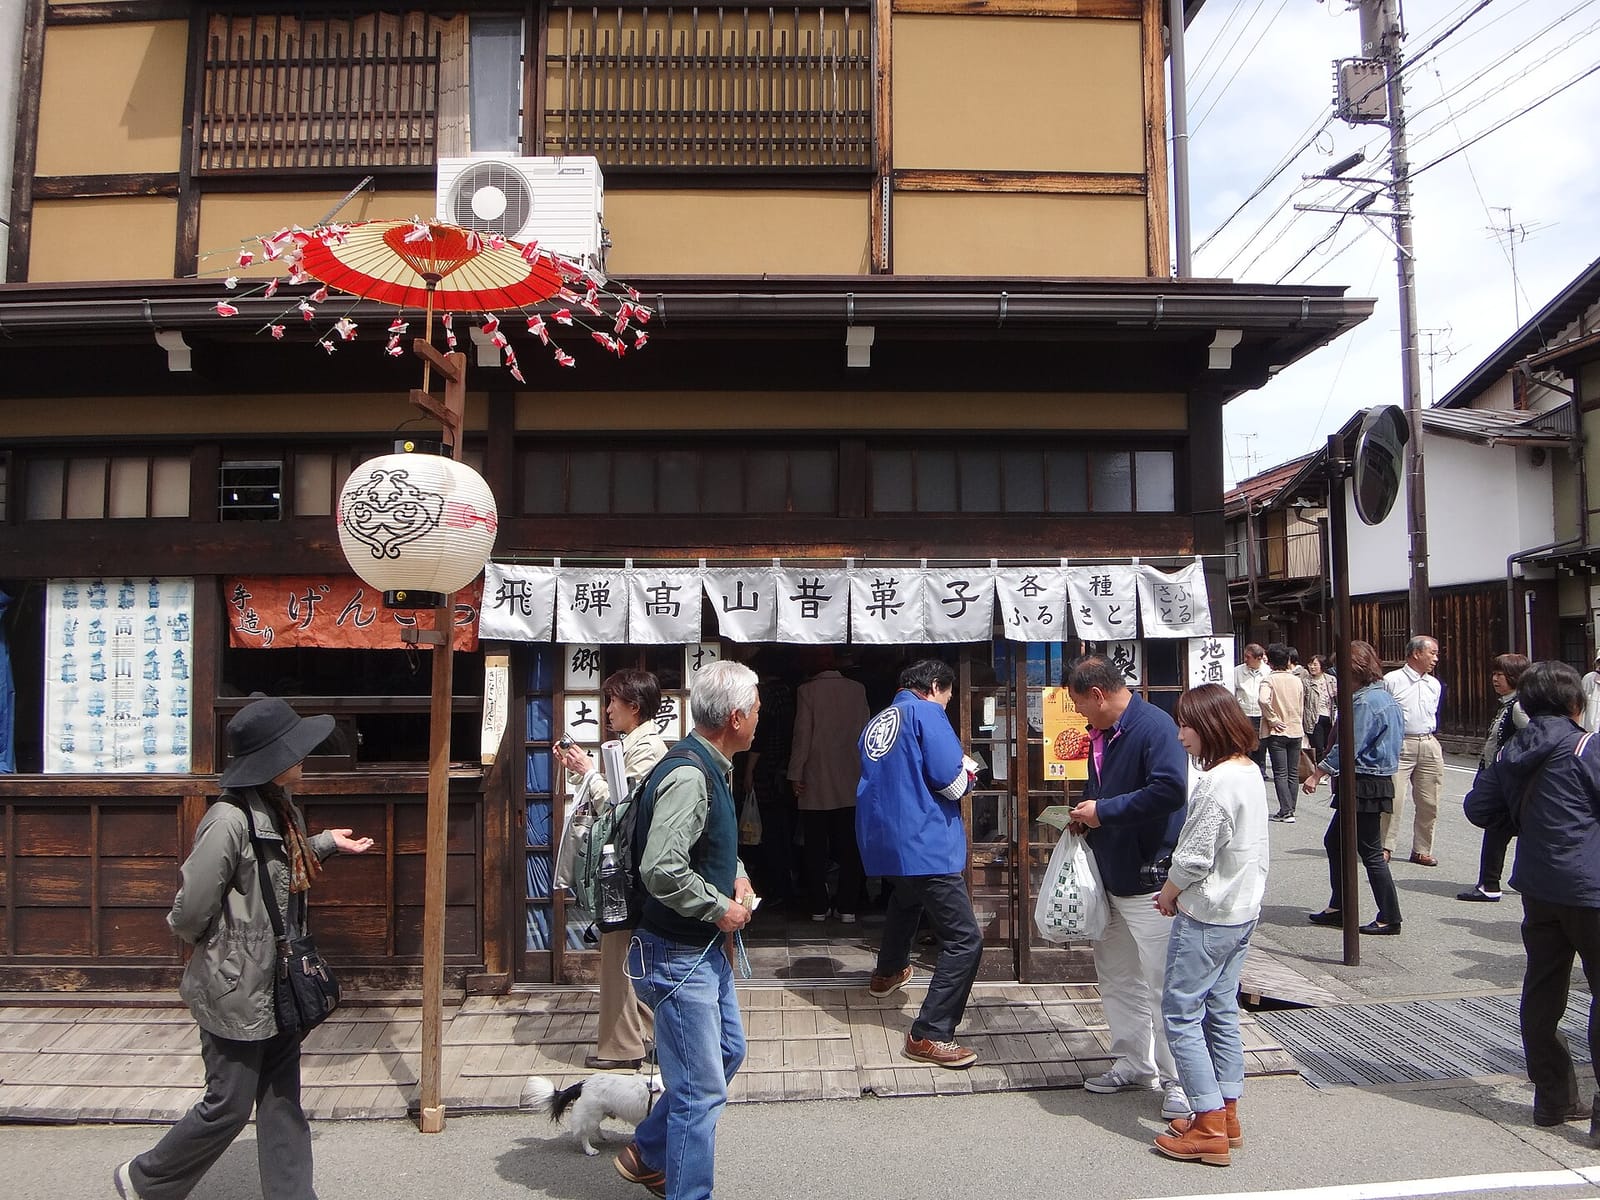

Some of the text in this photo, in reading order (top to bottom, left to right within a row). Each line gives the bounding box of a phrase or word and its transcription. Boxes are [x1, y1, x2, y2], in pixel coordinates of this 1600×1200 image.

[230, 583, 275, 647] 手造り
[287, 584, 476, 630] げんつ
[1008, 604, 1122, 627] ふるさと
[1200, 637, 1225, 682] 地酒
